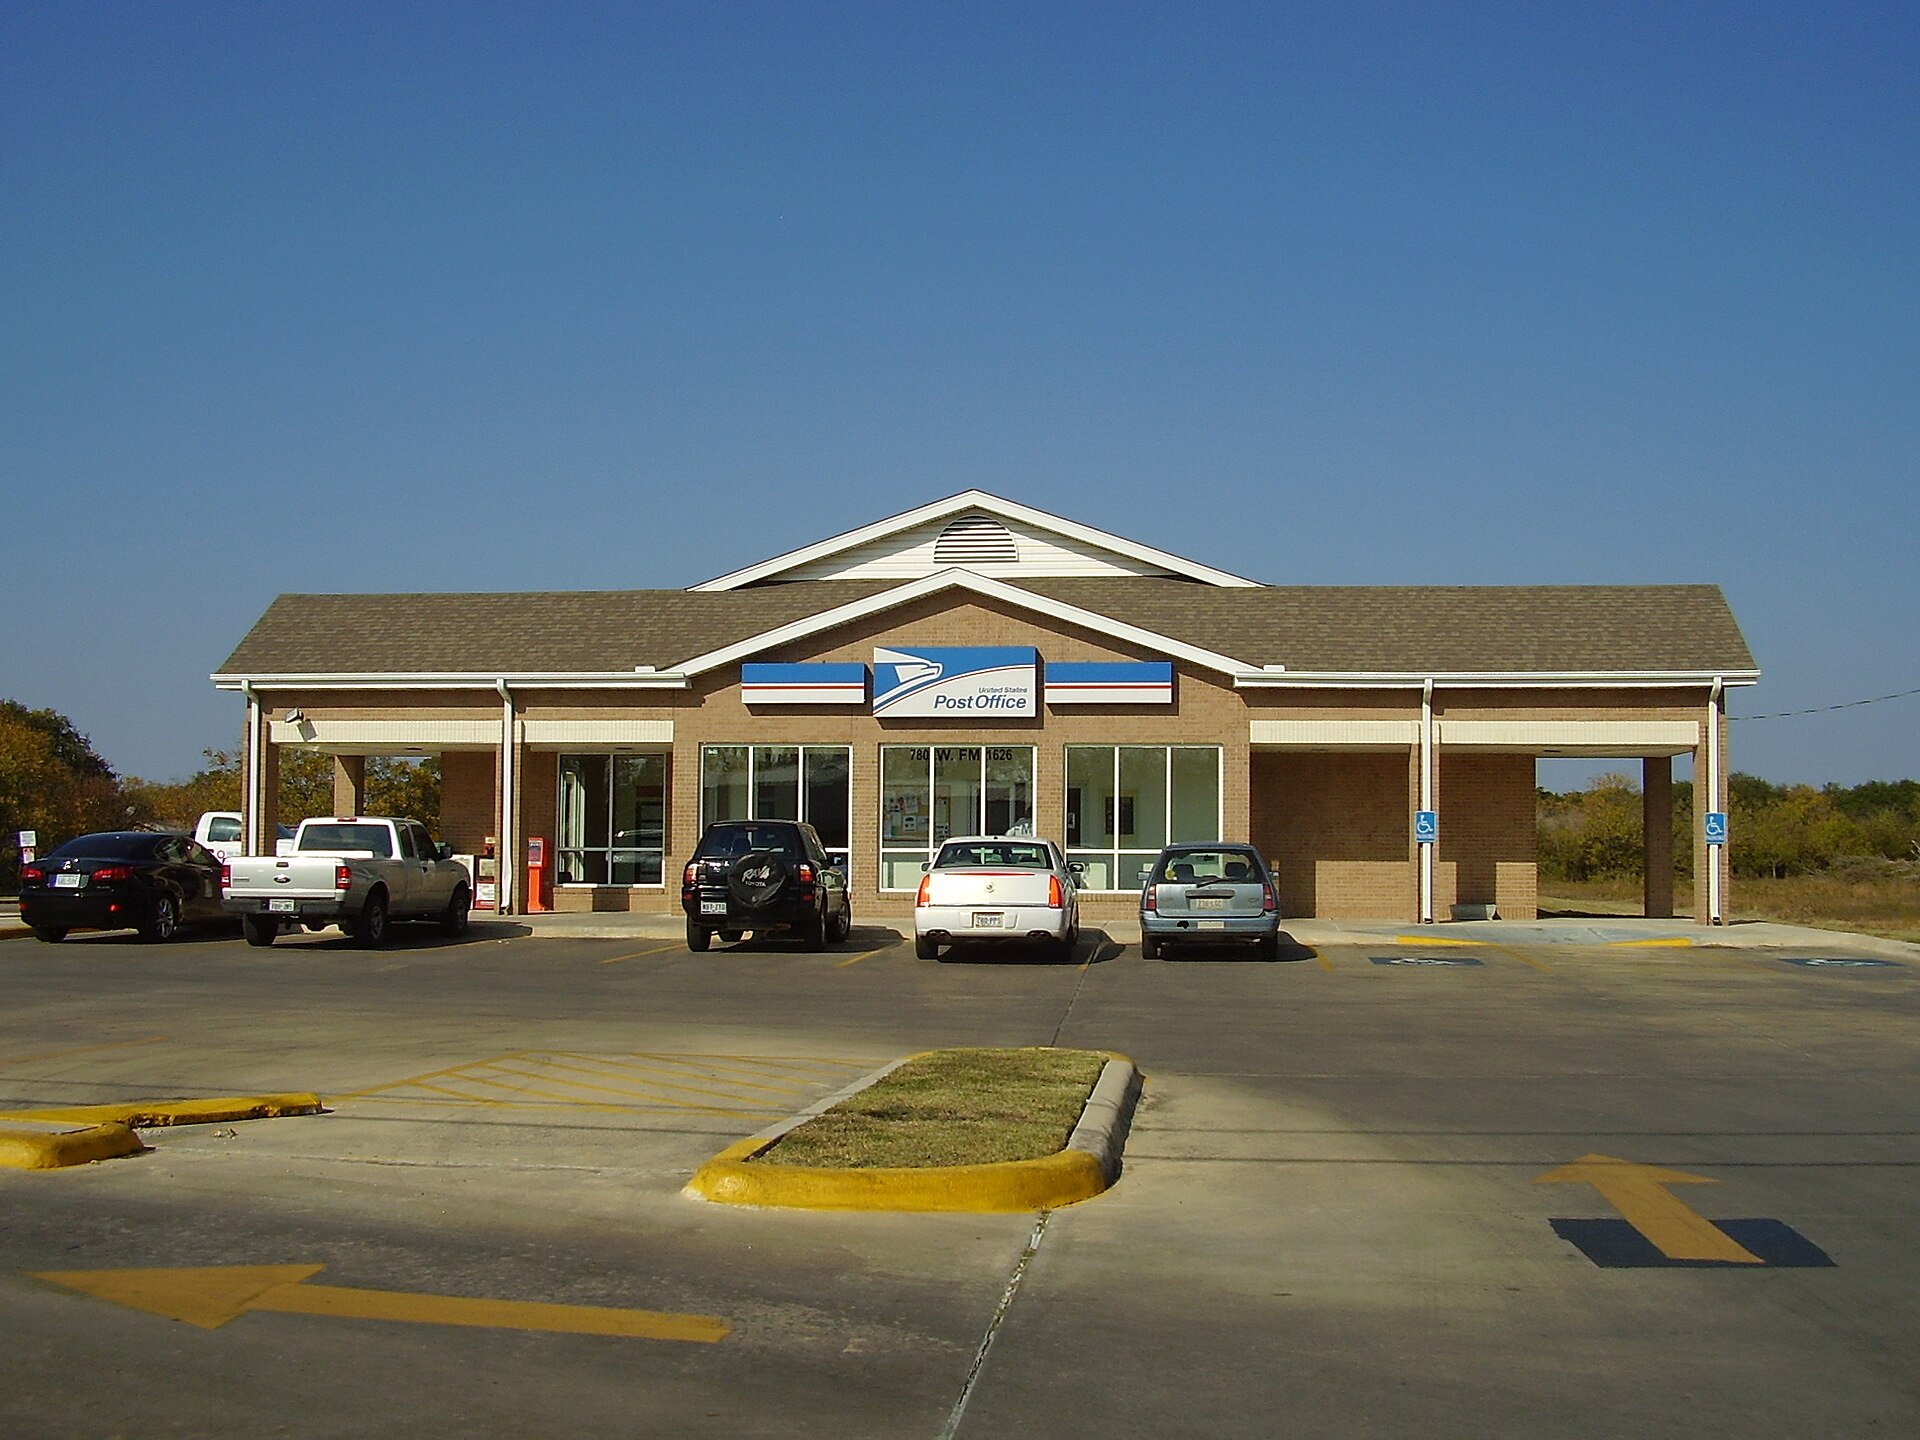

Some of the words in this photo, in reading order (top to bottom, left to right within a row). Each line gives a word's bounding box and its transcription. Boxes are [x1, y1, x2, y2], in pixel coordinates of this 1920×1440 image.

[934, 695, 974, 708] Post
[975, 694, 1026, 708] Office
[910, 749, 930, 761] 780
[959, 749, 980, 761] FM
[987, 749, 1012, 761] 1626
